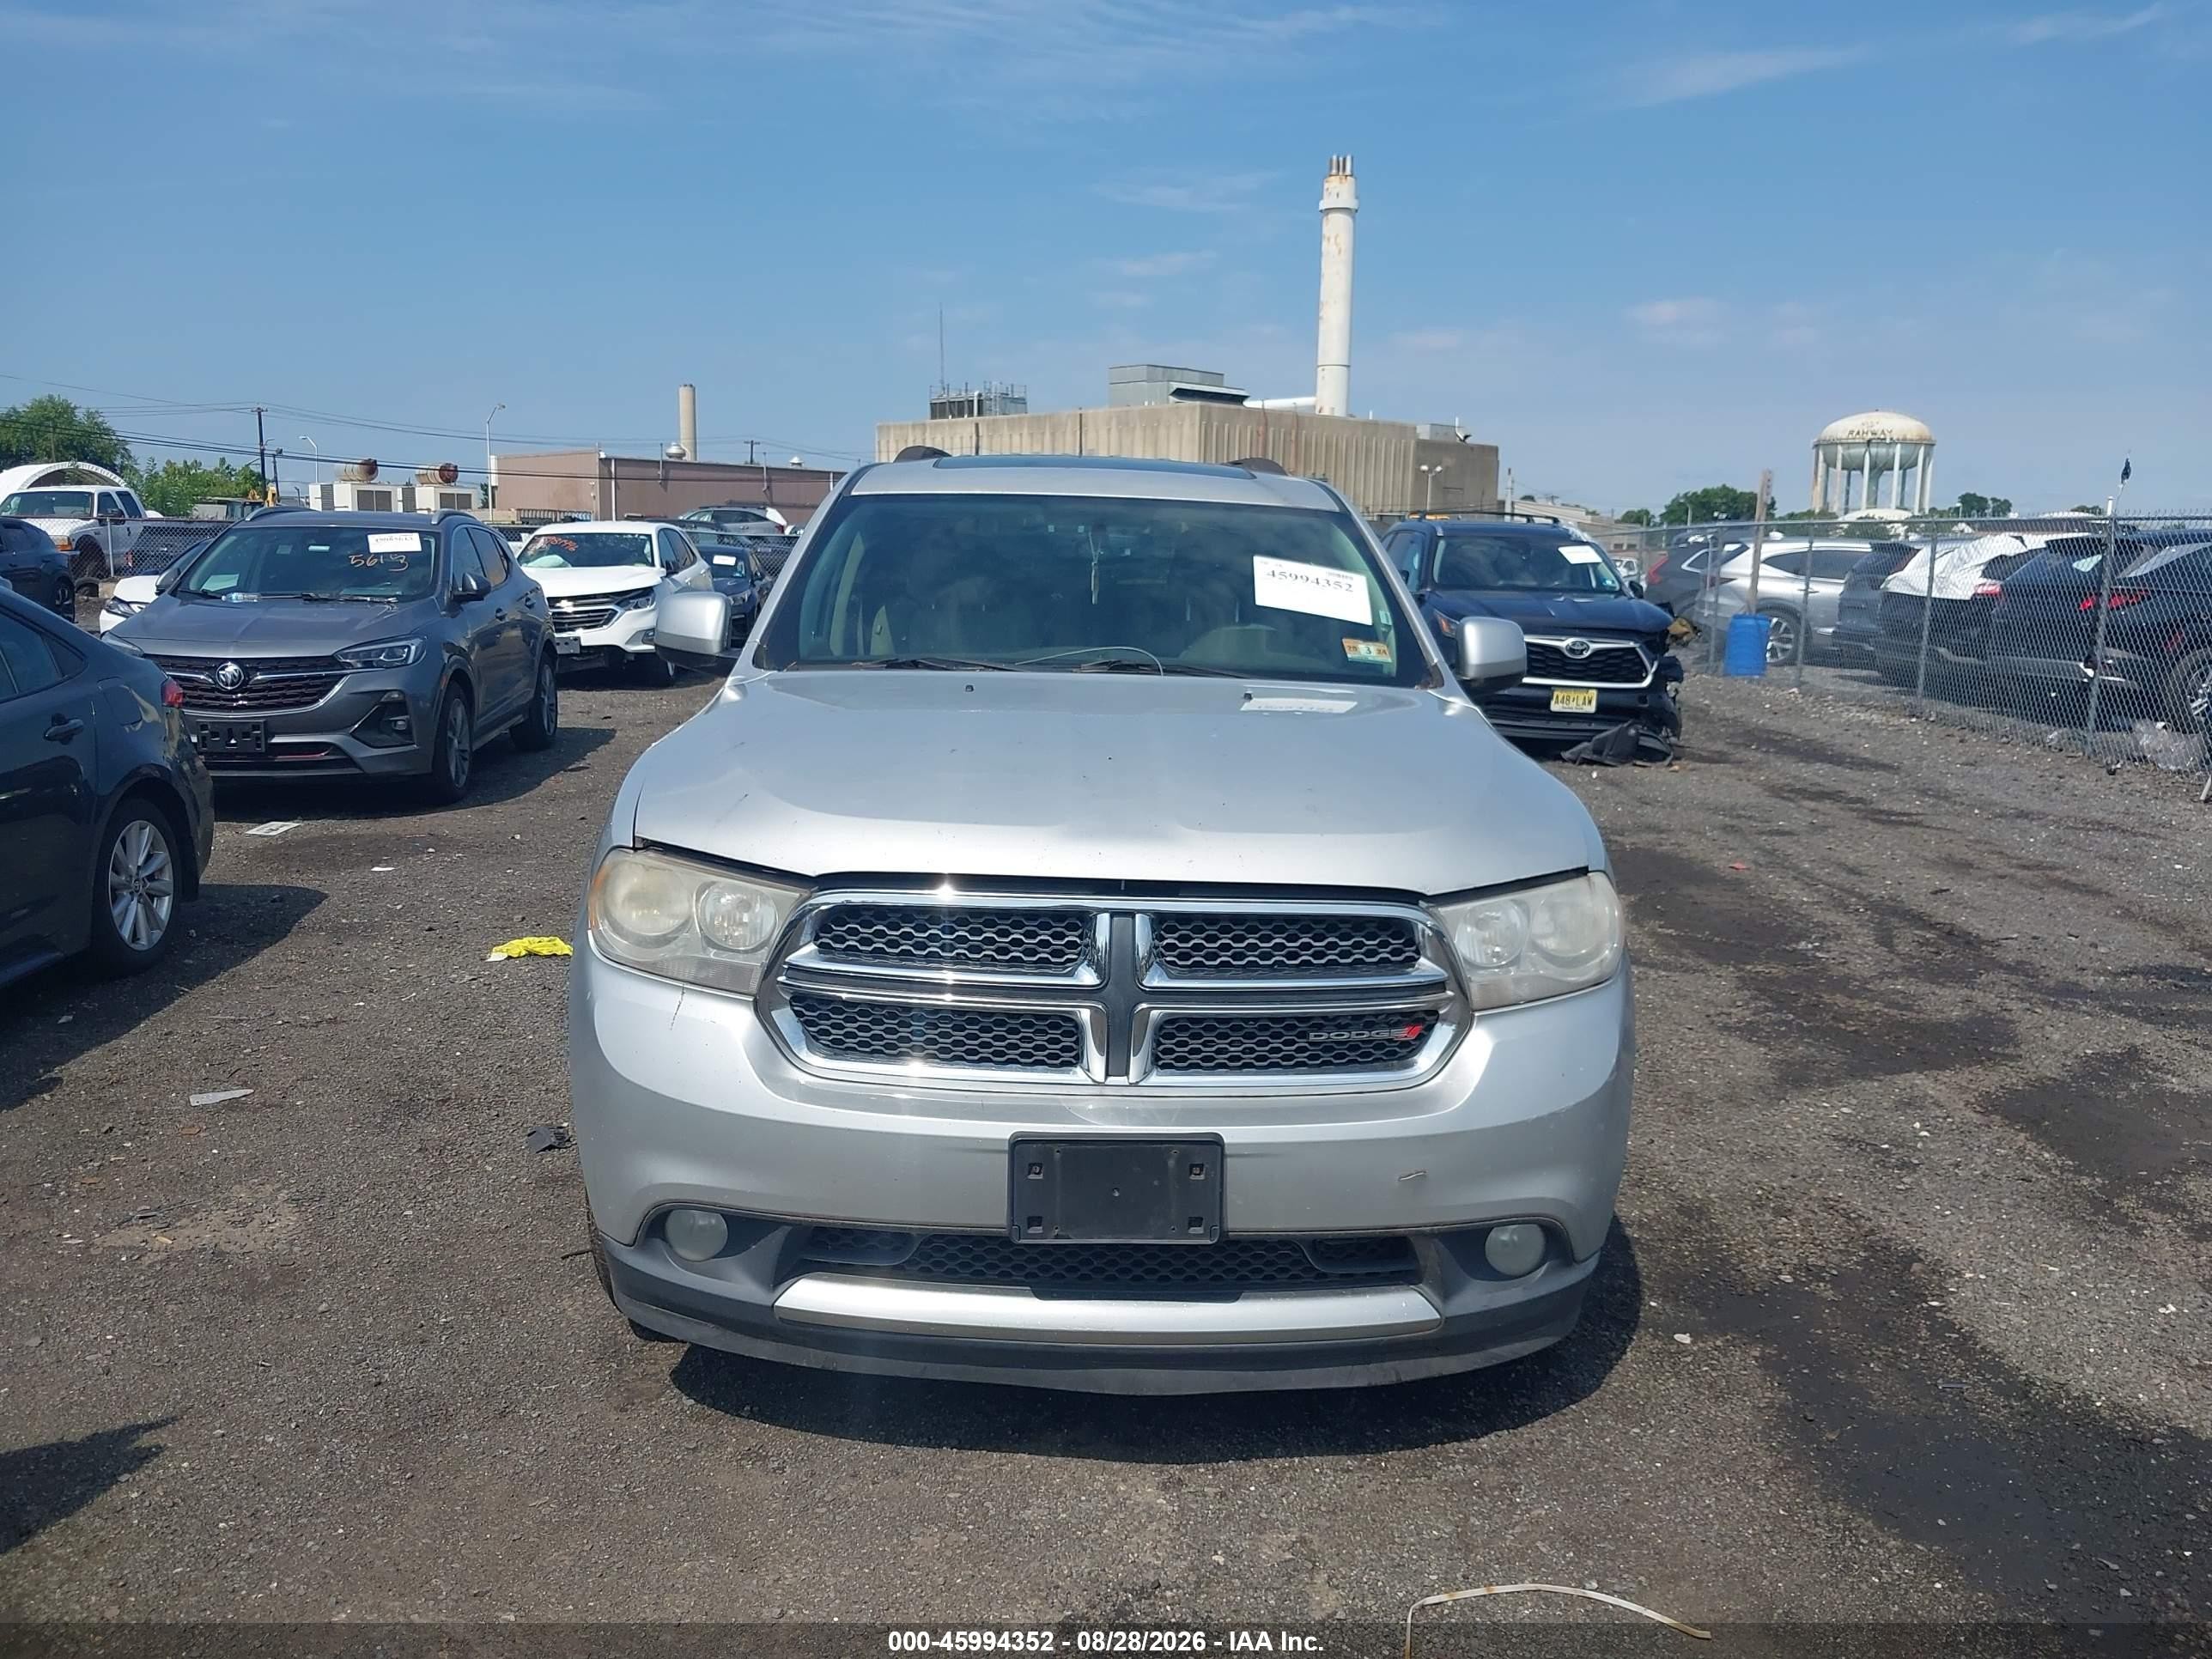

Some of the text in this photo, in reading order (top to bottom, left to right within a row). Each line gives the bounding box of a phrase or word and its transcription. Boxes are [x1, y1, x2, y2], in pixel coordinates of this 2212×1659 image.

[1847, 429, 1893, 438] RAHWAY
[1267, 569, 1354, 593] 45994352
[1364, 646, 1372, 655] 3
[1309, 1030, 1408, 1042] DODGE
